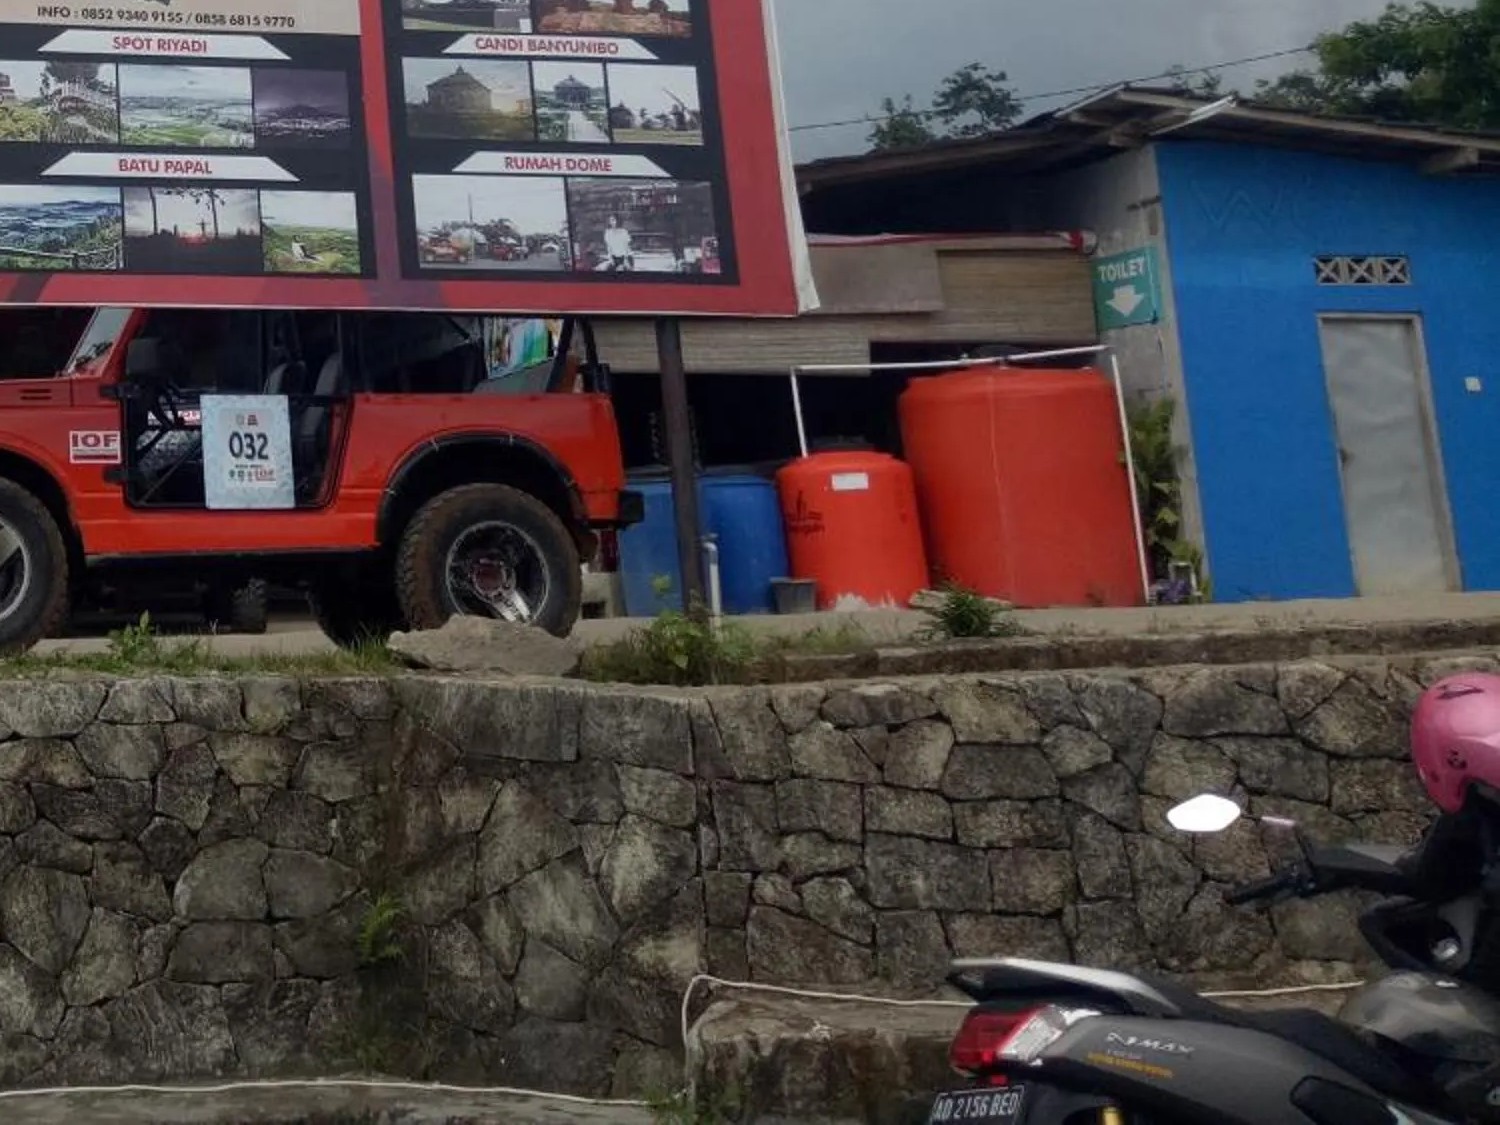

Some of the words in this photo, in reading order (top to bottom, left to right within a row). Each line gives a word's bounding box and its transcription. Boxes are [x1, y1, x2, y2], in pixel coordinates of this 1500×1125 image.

[37, 6, 71, 18] INFO
[81, 7, 114, 20] 0852
[117, 8, 149, 22] 9340
[151, 10, 183, 24] 9155
[263, 15, 296, 28] 9770
[112, 36, 151, 51] SPOT
[157, 37, 208, 54] RIYADI
[475, 36, 523, 52] CANDI
[527, 38, 620, 55] BANYUNIBO
[118, 158, 160, 173] BATU
[163, 159, 213, 175] PAPAL
[504, 156, 562, 171] RUMAH
[566, 157, 613, 172] DOME
[1097, 256, 1146, 283] TOILET
[71, 433, 118, 448] IOF
[228, 431, 269, 460] 032
[954, 1095, 991, 1119] 2156
